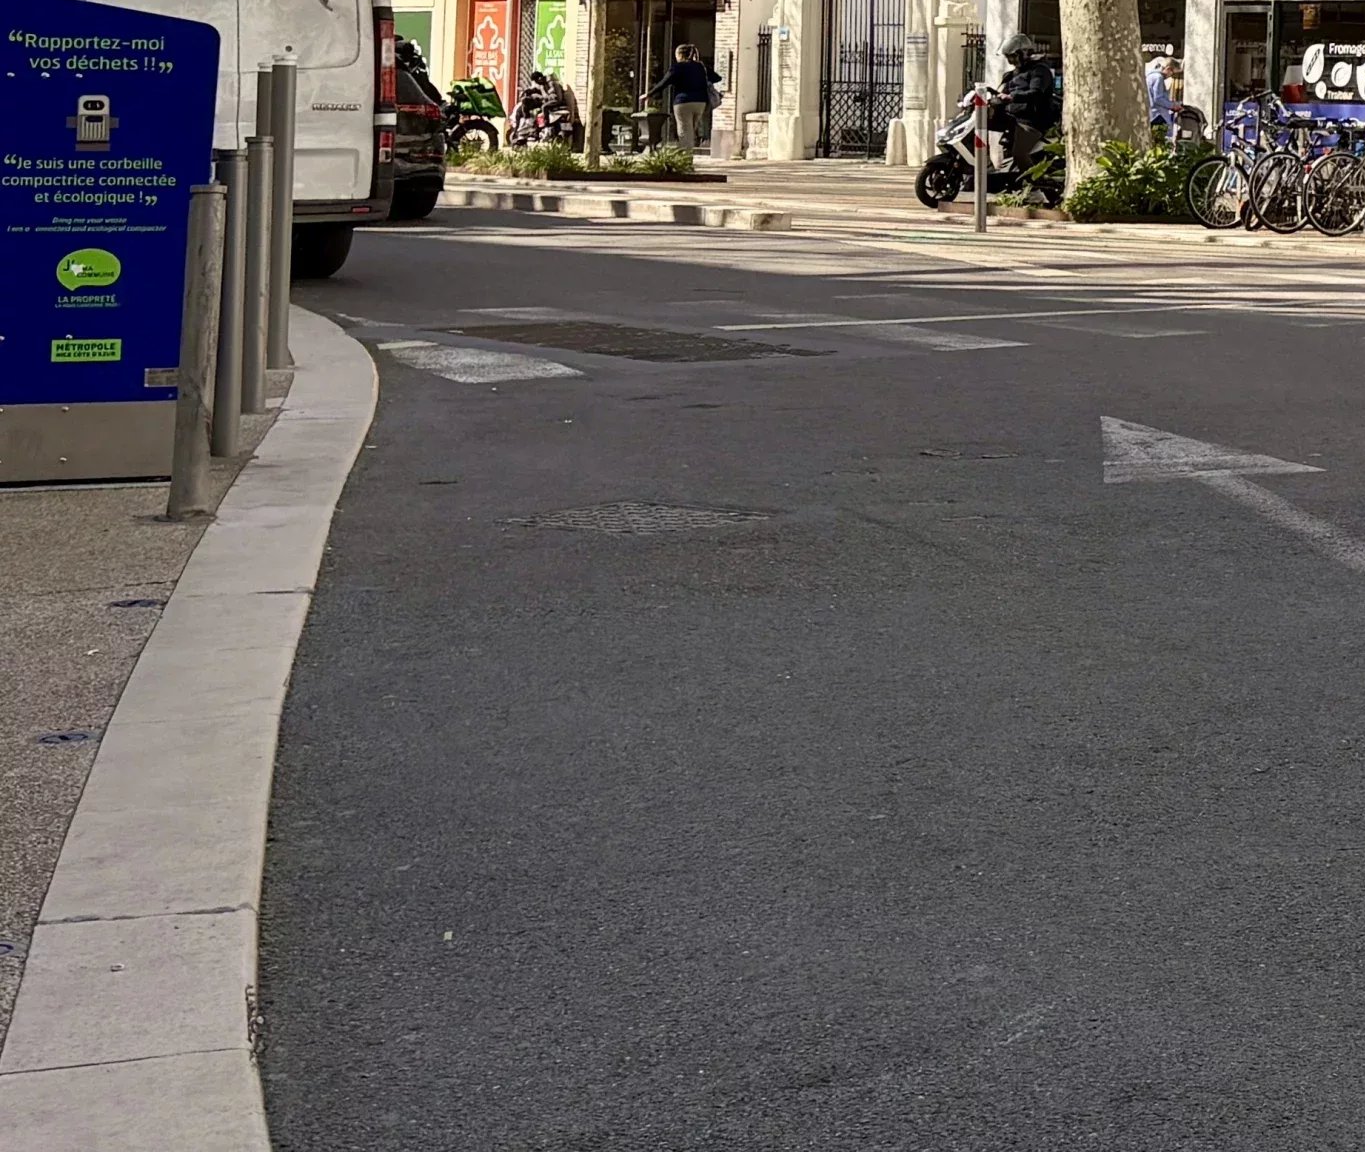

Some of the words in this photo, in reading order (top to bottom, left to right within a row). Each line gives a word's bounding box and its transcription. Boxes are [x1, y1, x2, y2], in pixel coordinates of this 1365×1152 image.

[29, 57, 61, 70] vos
[66, 55, 139, 71] déchets
[36, 157, 64, 170] suis
[68, 159, 95, 170] une
[99, 157, 163, 170] corbeille
[2, 174, 95, 188] compactrice
[98, 173, 177, 187] connectée
[34, 192, 50, 203] et
[53, 190, 135, 206] écologique
[70, 294, 117, 303] PROPRETÉ
[56, 342, 117, 352] MÉTROPOLE
